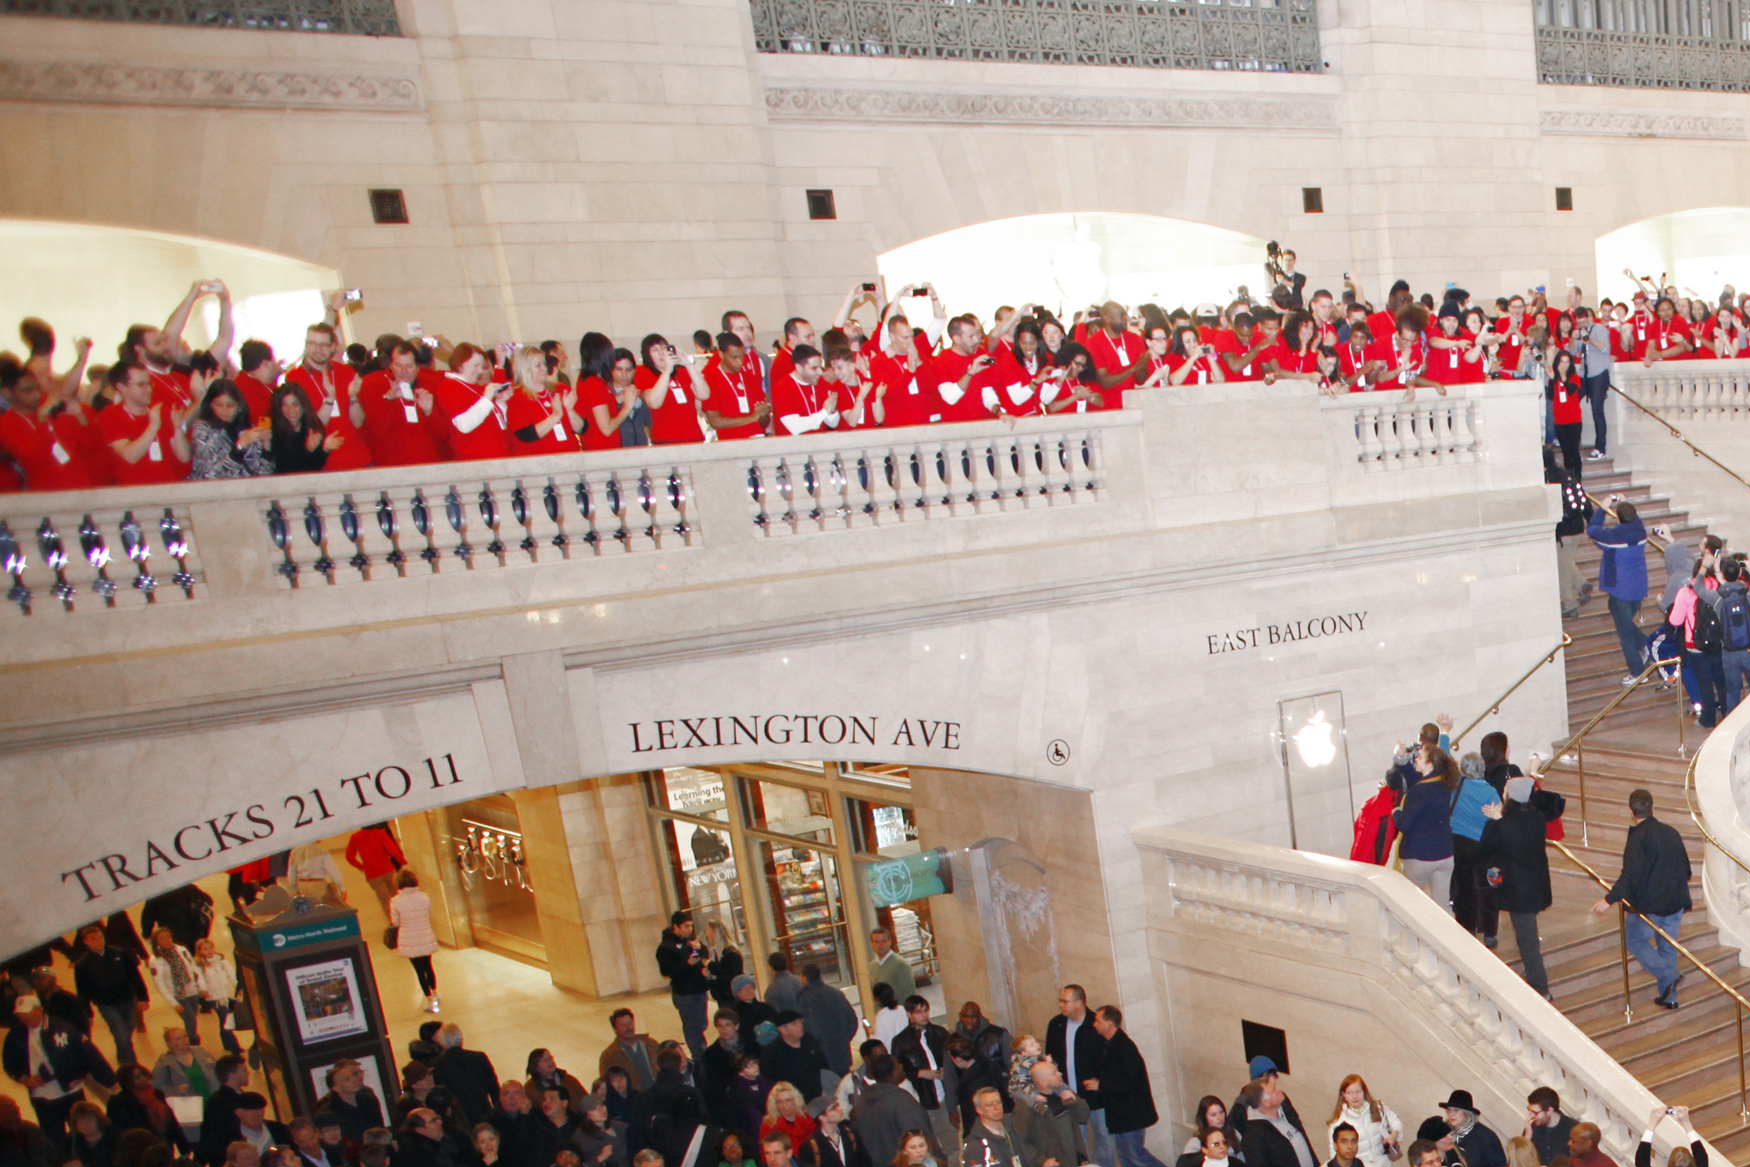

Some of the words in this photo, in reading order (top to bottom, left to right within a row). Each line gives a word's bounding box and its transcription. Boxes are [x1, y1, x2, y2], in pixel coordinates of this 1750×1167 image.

[1206, 628, 1261, 655] EAST
[1267, 611, 1368, 645] BALCONY
[628, 714, 878, 753] LEXINGTON
[891, 717, 961, 750] AVE
[61, 804, 276, 903] TRACKS
[284, 788, 335, 830] 21
[340, 765, 412, 809] TO
[422, 752, 464, 790] 11
[689, 873, 711, 887] NEW
